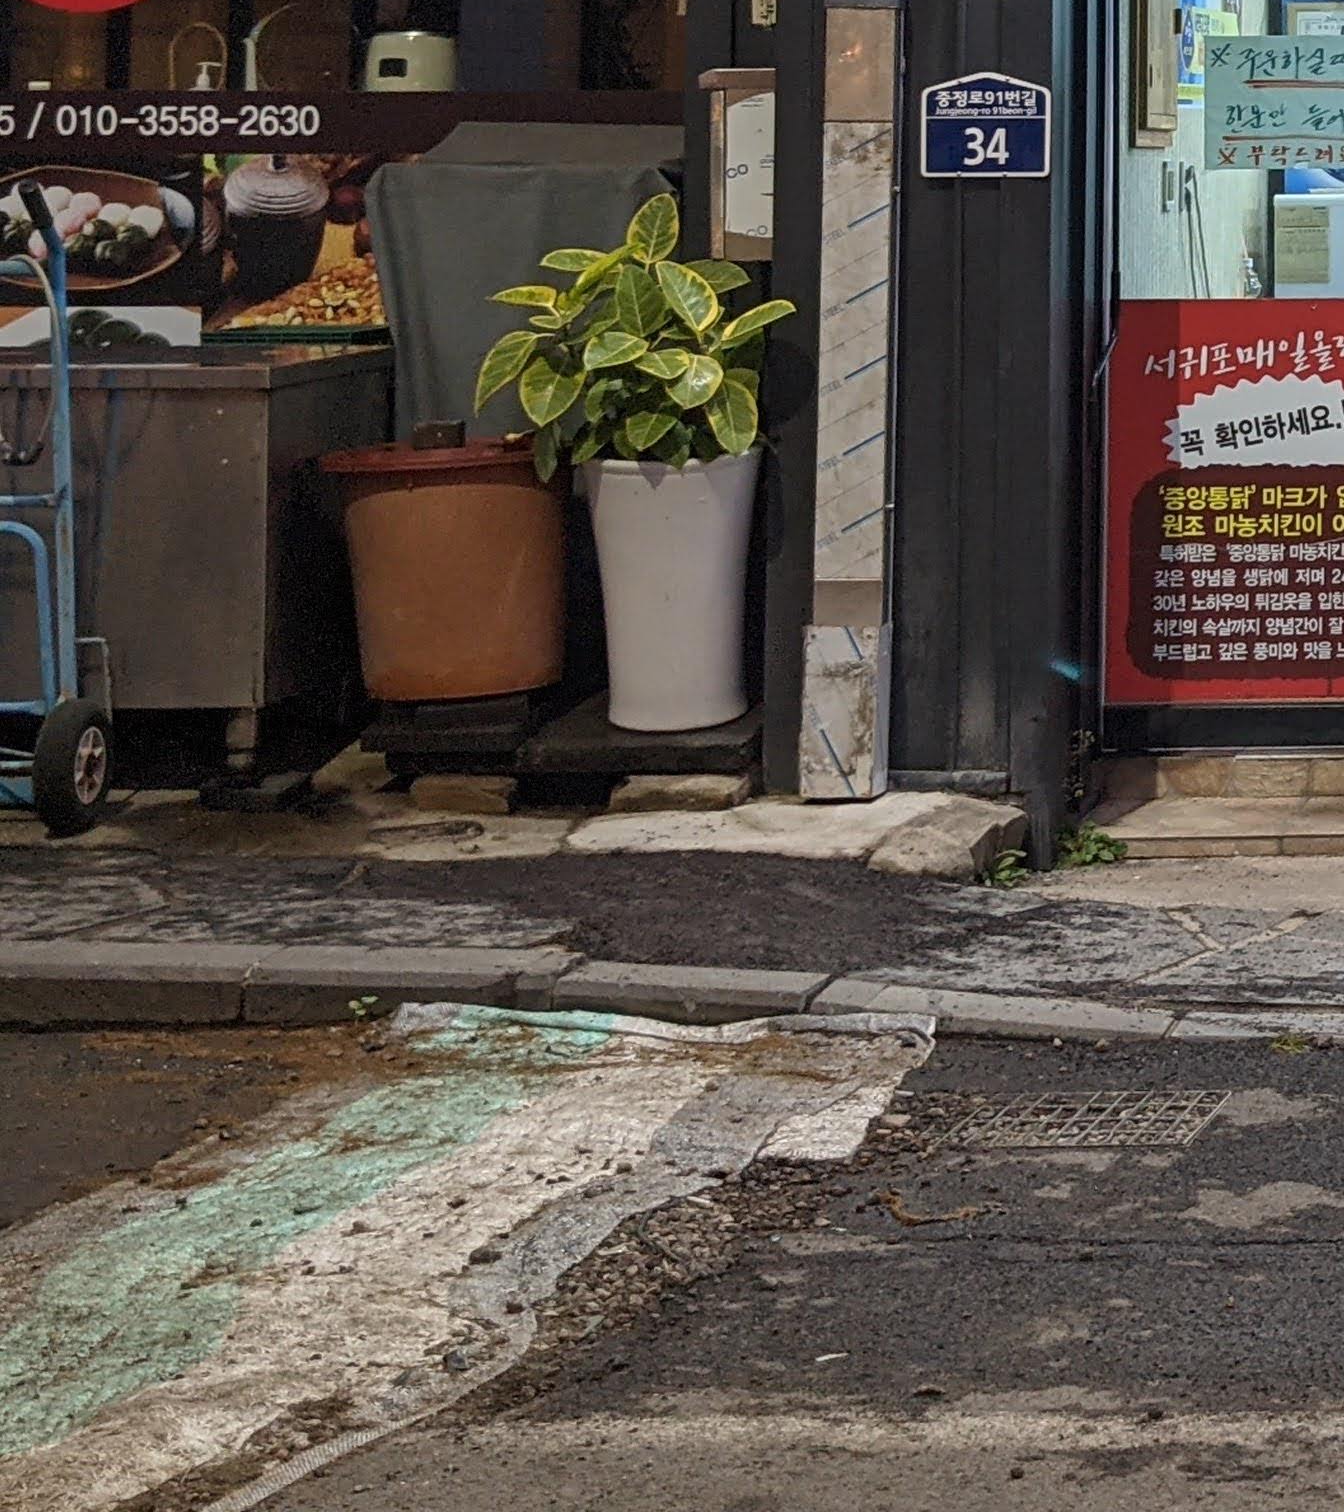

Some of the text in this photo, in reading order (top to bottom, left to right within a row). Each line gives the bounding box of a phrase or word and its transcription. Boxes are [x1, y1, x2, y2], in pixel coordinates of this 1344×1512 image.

[935, 89, 1038, 107] 중정로91번길
[55, 103, 321, 137] 010-3558-2630
[935, 106, 1038, 118] Jungjeong-ro 91beon-gil
[962, 127, 1010, 167] 34
[1180, 428, 1205, 457] 꼭
[1262, 485, 1328, 509] 마크가
[1161, 513, 1205, 538] 원조
[1214, 513, 1324, 537] 마농치킨이
[1159, 544, 1217, 563] 특허받은
[1154, 569, 1184, 588] 갖은
[1191, 569, 1236, 587] 양념을
[1243, 569, 1289, 587] 생닭에
[1295, 569, 1325, 586] 저며
[1152, 594, 1187, 613] 30년
[1191, 594, 1250, 612] 노하우의
[1254, 593, 1313, 612] 튀김옷을
[1152, 618, 1197, 637] 치킨의
[1202, 618, 1260, 636] 속살까지
[1265, 617, 1324, 636] 양념간이
[1328, 617, 1343, 635] 잘
[1152, 643, 1212, 662] 부드럽고
[1218, 643, 1249, 661] 깊은
[1253, 642, 1298, 661] 풍미와
[1303, 641, 1332, 660] 맛을
